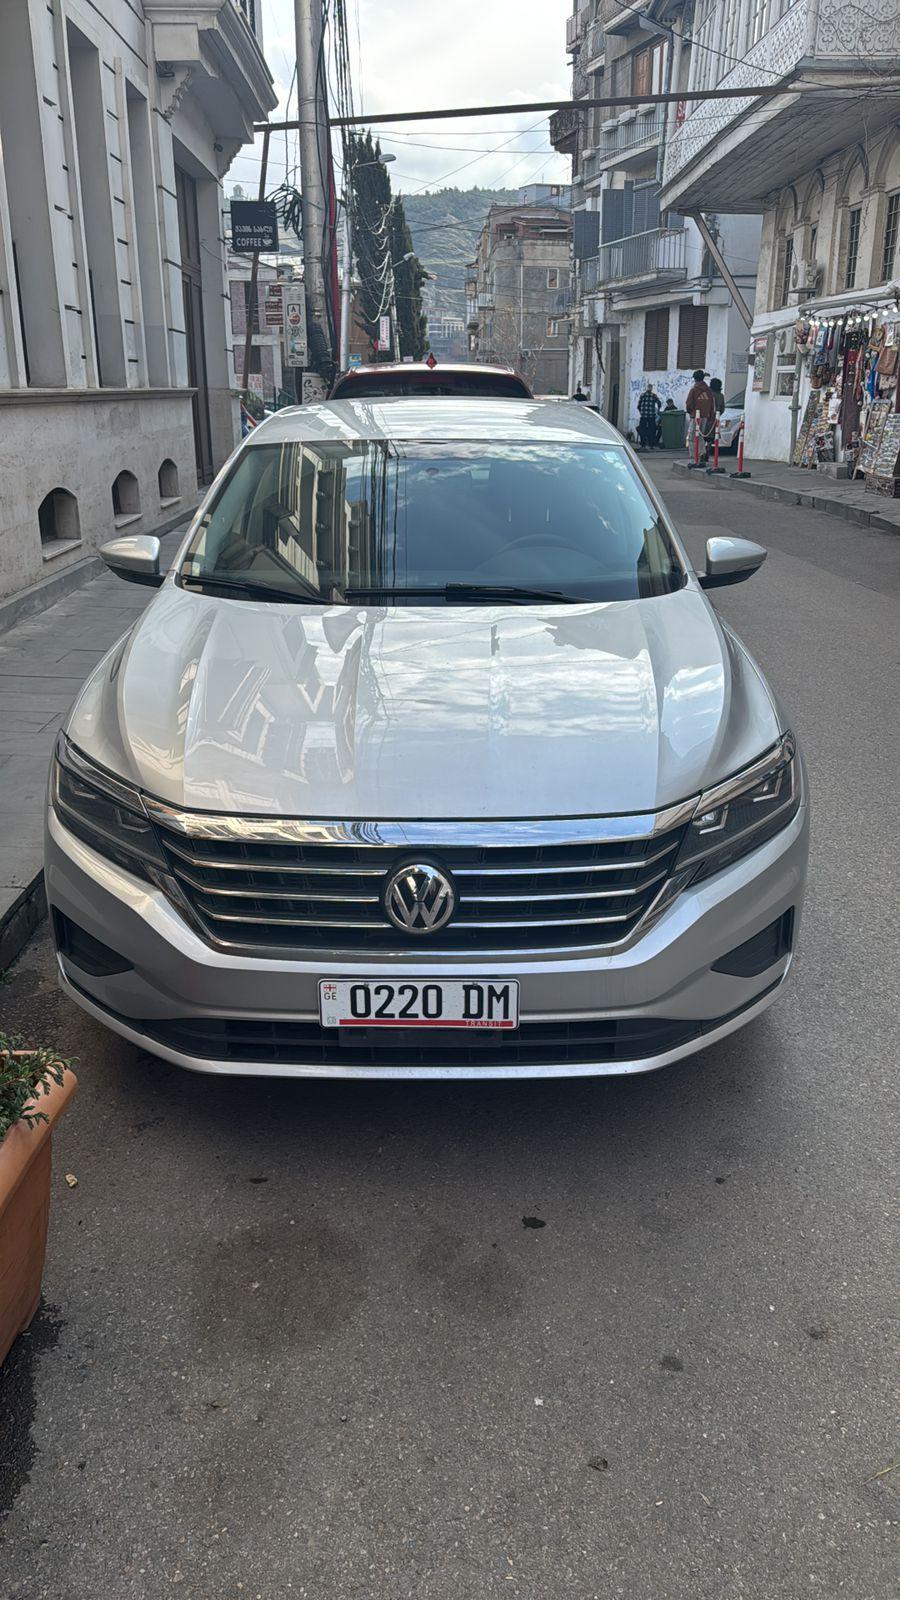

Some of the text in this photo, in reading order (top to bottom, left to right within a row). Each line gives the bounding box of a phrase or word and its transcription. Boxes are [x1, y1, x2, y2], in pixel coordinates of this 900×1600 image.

[236, 238, 262, 247] COFFEE
[323, 992, 337, 1000] GE
[350, 984, 510, 1019] 0220 DM
